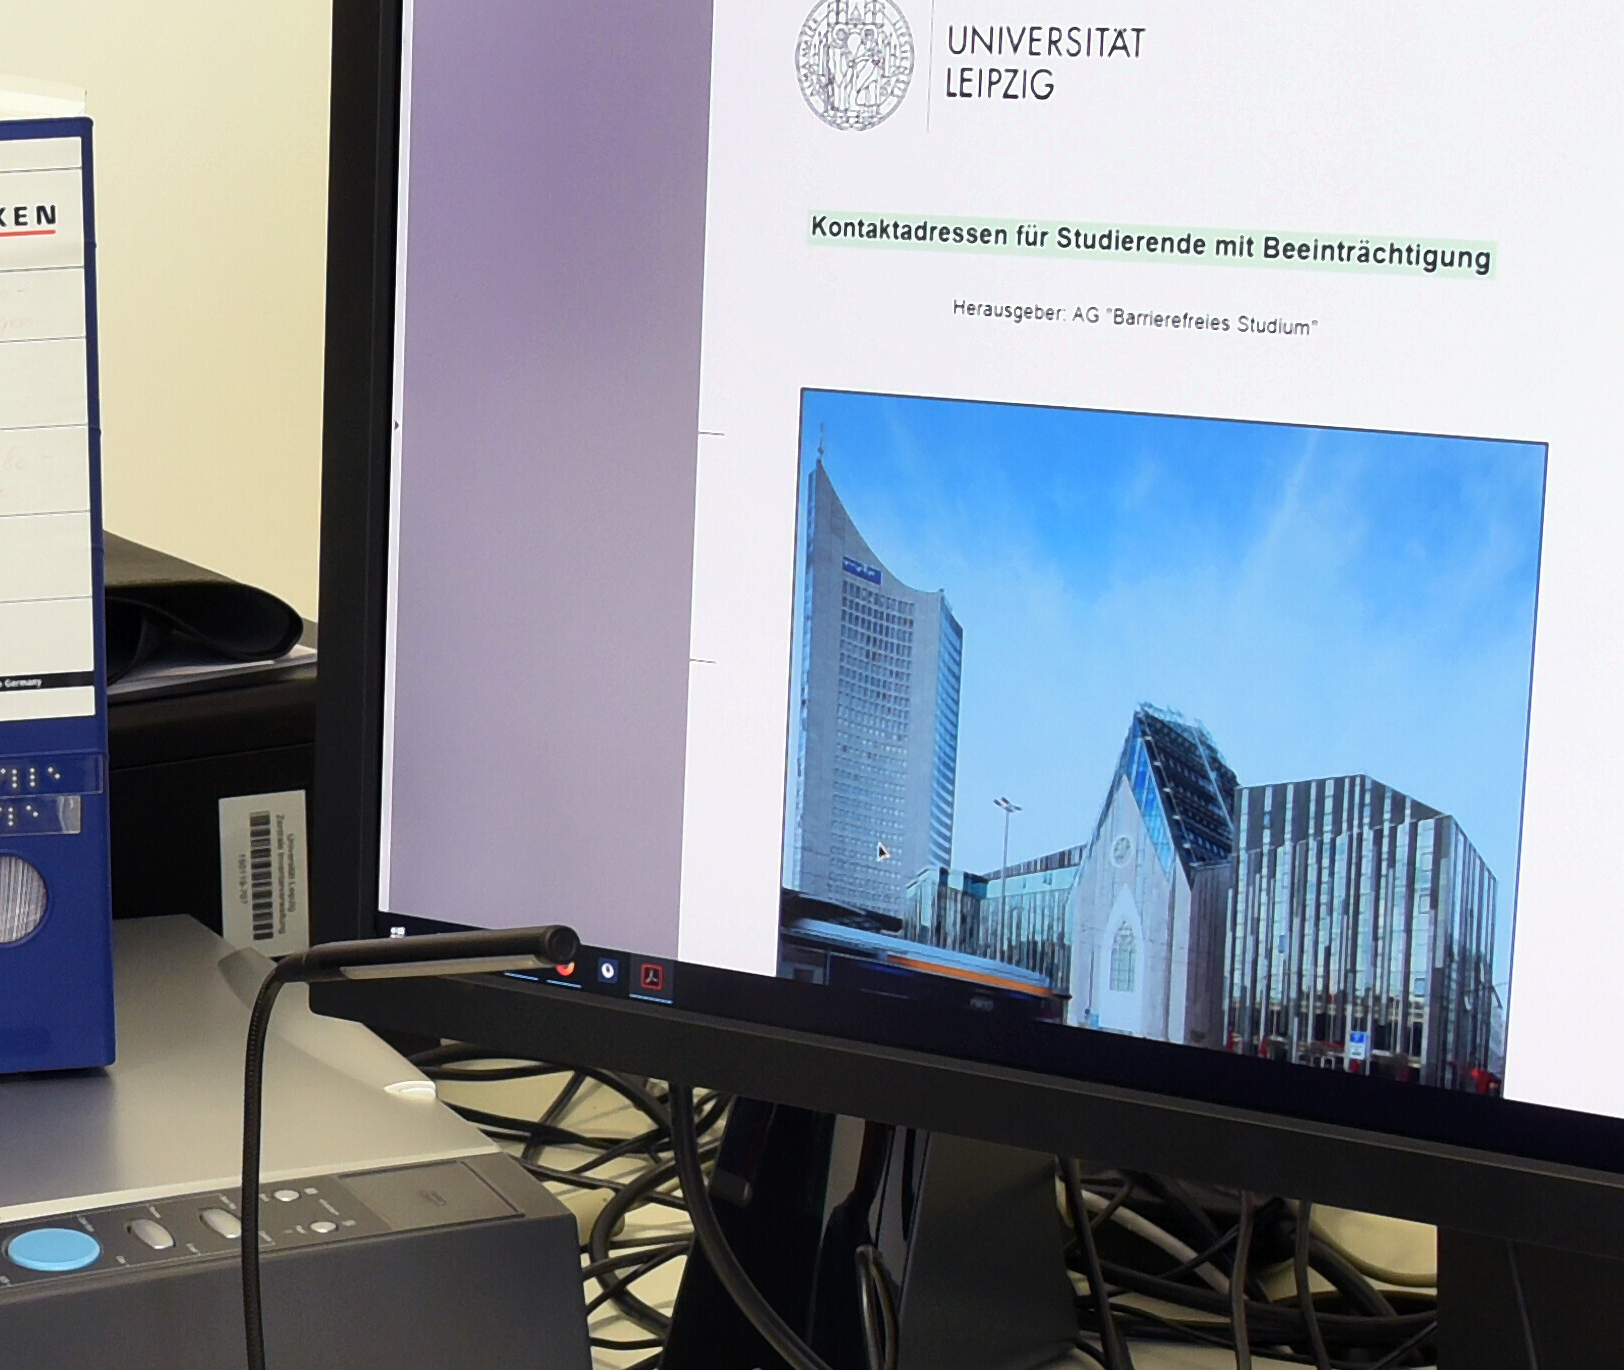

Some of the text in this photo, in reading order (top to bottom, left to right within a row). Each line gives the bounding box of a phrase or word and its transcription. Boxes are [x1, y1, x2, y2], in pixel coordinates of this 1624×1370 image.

[948, 24, 1147, 58] UNIVERSITÄT
[946, 66, 1055, 100] LEIPZIG
[811, 214, 1493, 276] Kontaktadressen für Studierende mit Beeinträchtigung
[952, 298, 1067, 324] Herausgeber:
[1071, 305, 1101, 324] AG
[4, 678, 43, 688] Germany
